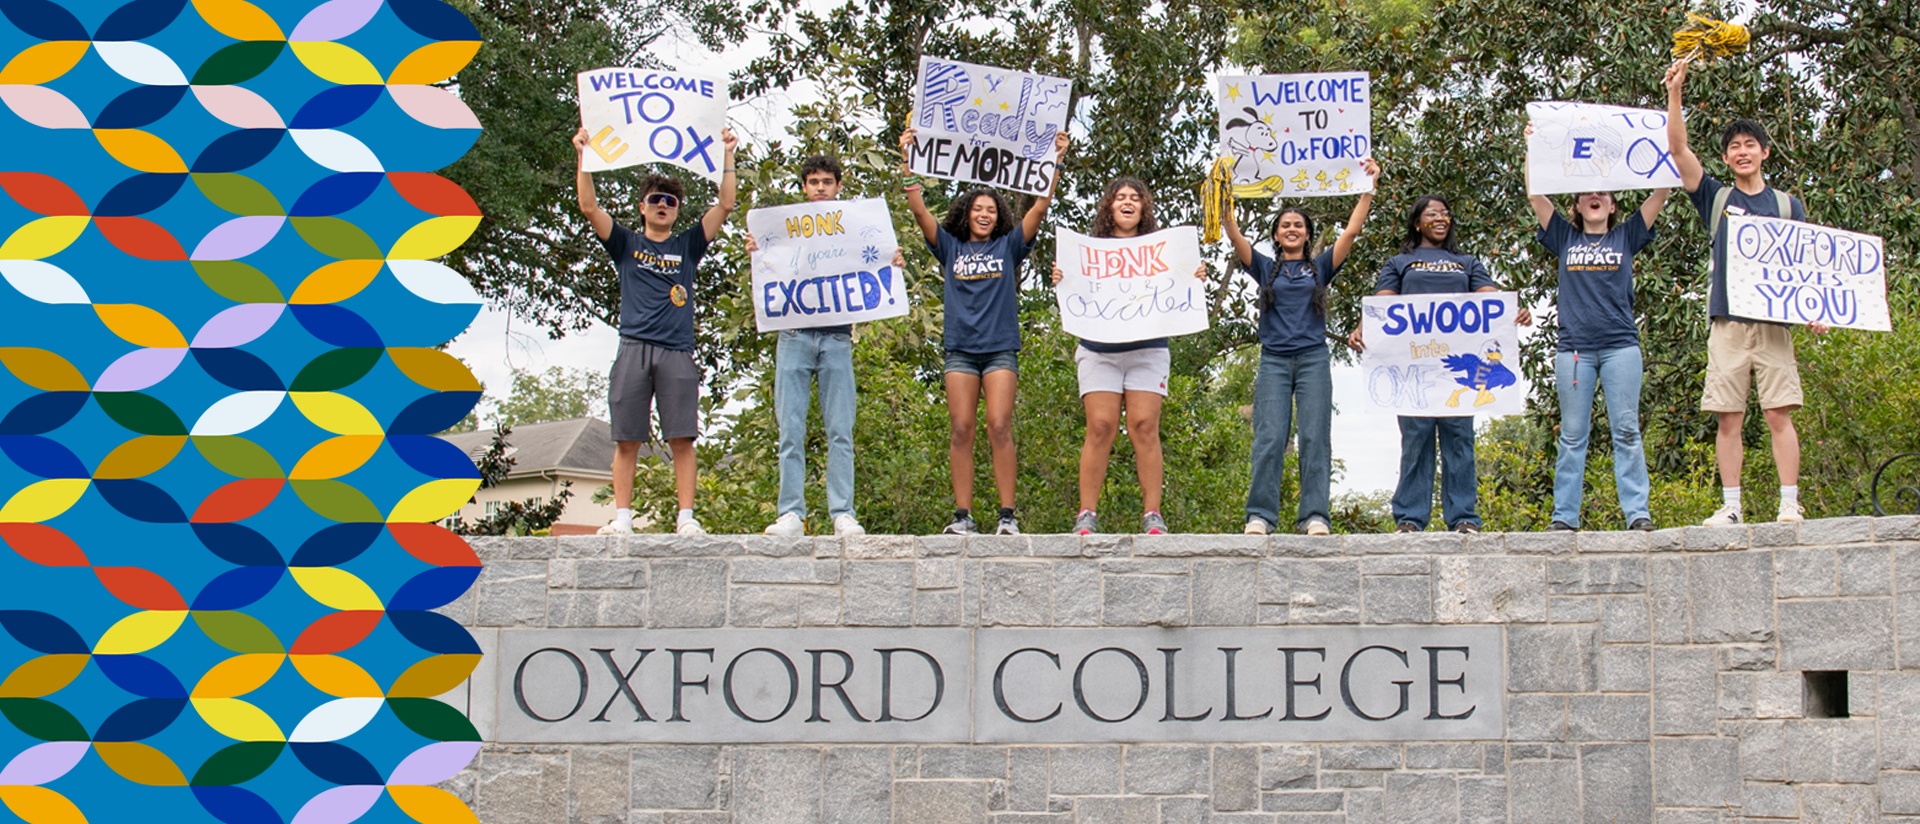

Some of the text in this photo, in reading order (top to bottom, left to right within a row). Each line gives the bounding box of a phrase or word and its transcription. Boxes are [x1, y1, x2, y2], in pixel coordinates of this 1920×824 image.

[589, 72, 714, 98] WELCOME
[1251, 78, 1364, 106] WELCOME
[609, 91, 675, 124] TO
[919, 62, 1058, 160] Ready
[1298, 109, 1328, 131] TO
[1612, 112, 1667, 130] TO
[588, 125, 716, 173] E OX
[969, 134, 990, 147] for
[1573, 138, 1595, 159] E
[910, 135, 1055, 192] MEMORIES
[1626, 137, 1681, 179] OX
[786, 210, 845, 238] HONK
[788, 245, 847, 275] if you're
[1078, 241, 1169, 279] HONK
[1566, 252, 1623, 265] IMPACT
[1737, 222, 1880, 275] OXFORD
[764, 266, 895, 317] EXCITED!
[1088, 279, 1153, 293] IF U R
[1763, 267, 1843, 286] LOVES
[1382, 299, 1505, 335] SWOOP
[1755, 284, 1857, 325] YOU
[1409, 339, 1450, 359] into
[512, 645, 1477, 723] OXFORD COLLEGE
